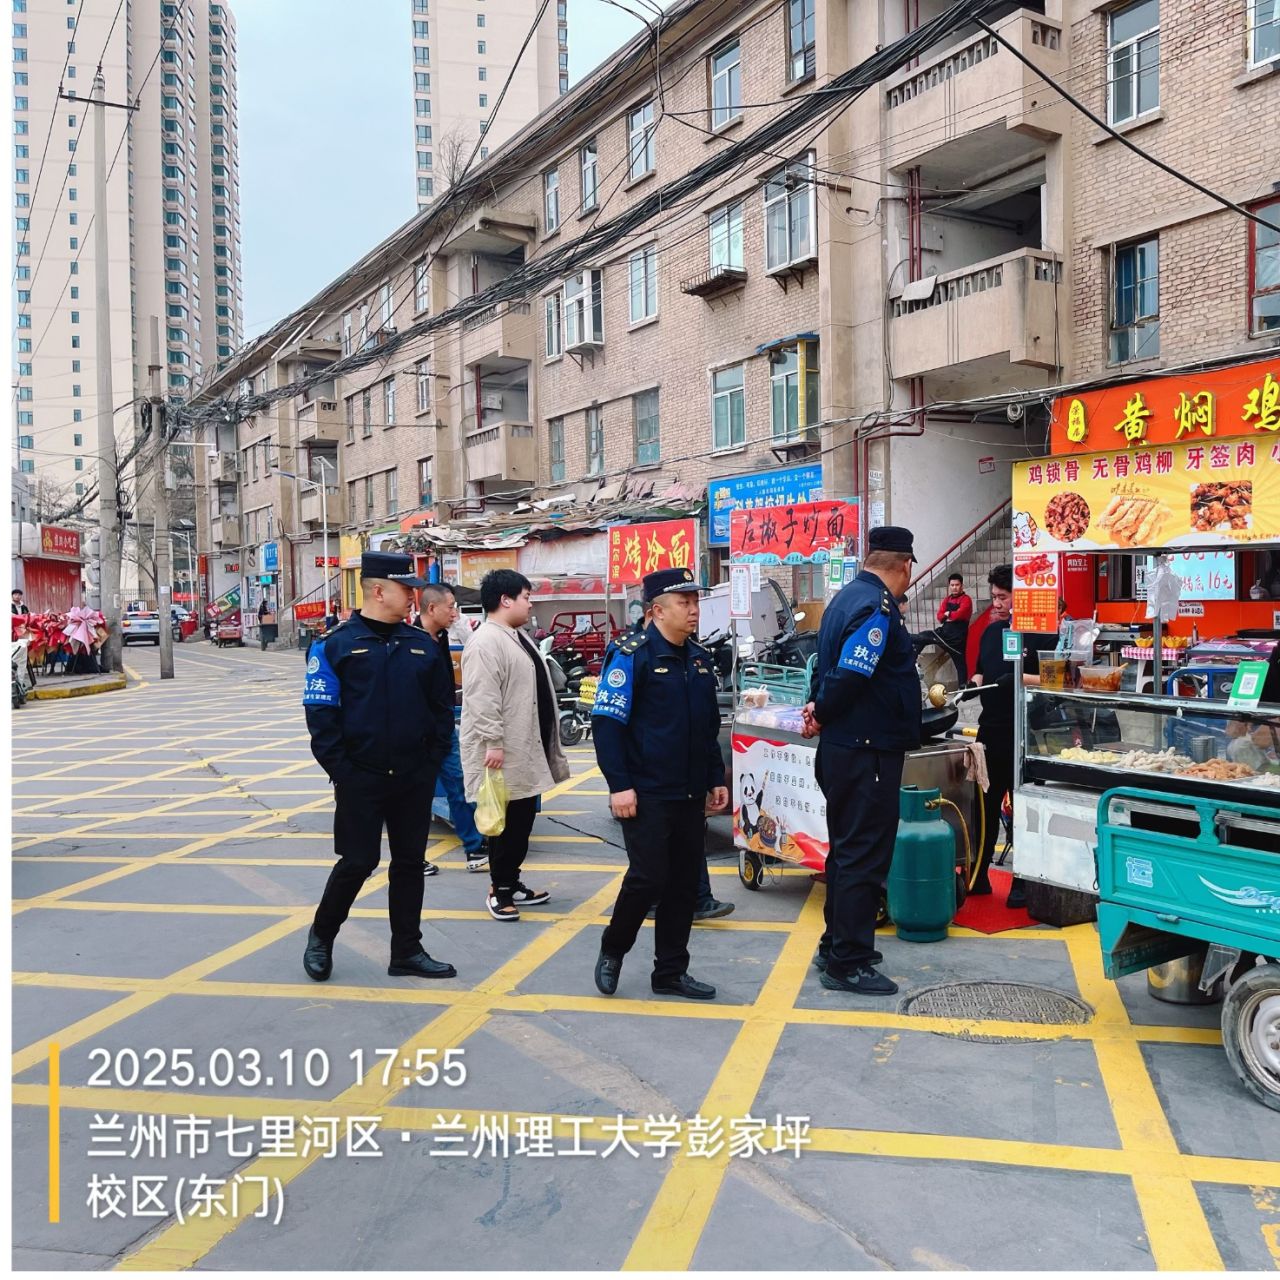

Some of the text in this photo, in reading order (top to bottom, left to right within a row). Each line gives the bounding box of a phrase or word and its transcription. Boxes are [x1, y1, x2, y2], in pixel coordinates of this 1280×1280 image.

[1114, 380, 1280, 440] 黄焖鸡
[1028, 442, 1256, 486] 鸡锁骨 无骨鸡柳 牙签肉
[612, 531, 621, 578] 哈尔滨
[622, 529, 690, 579] 烤冷面
[853, 645, 880, 666] 执法
[597, 689, 627, 708] 执法
